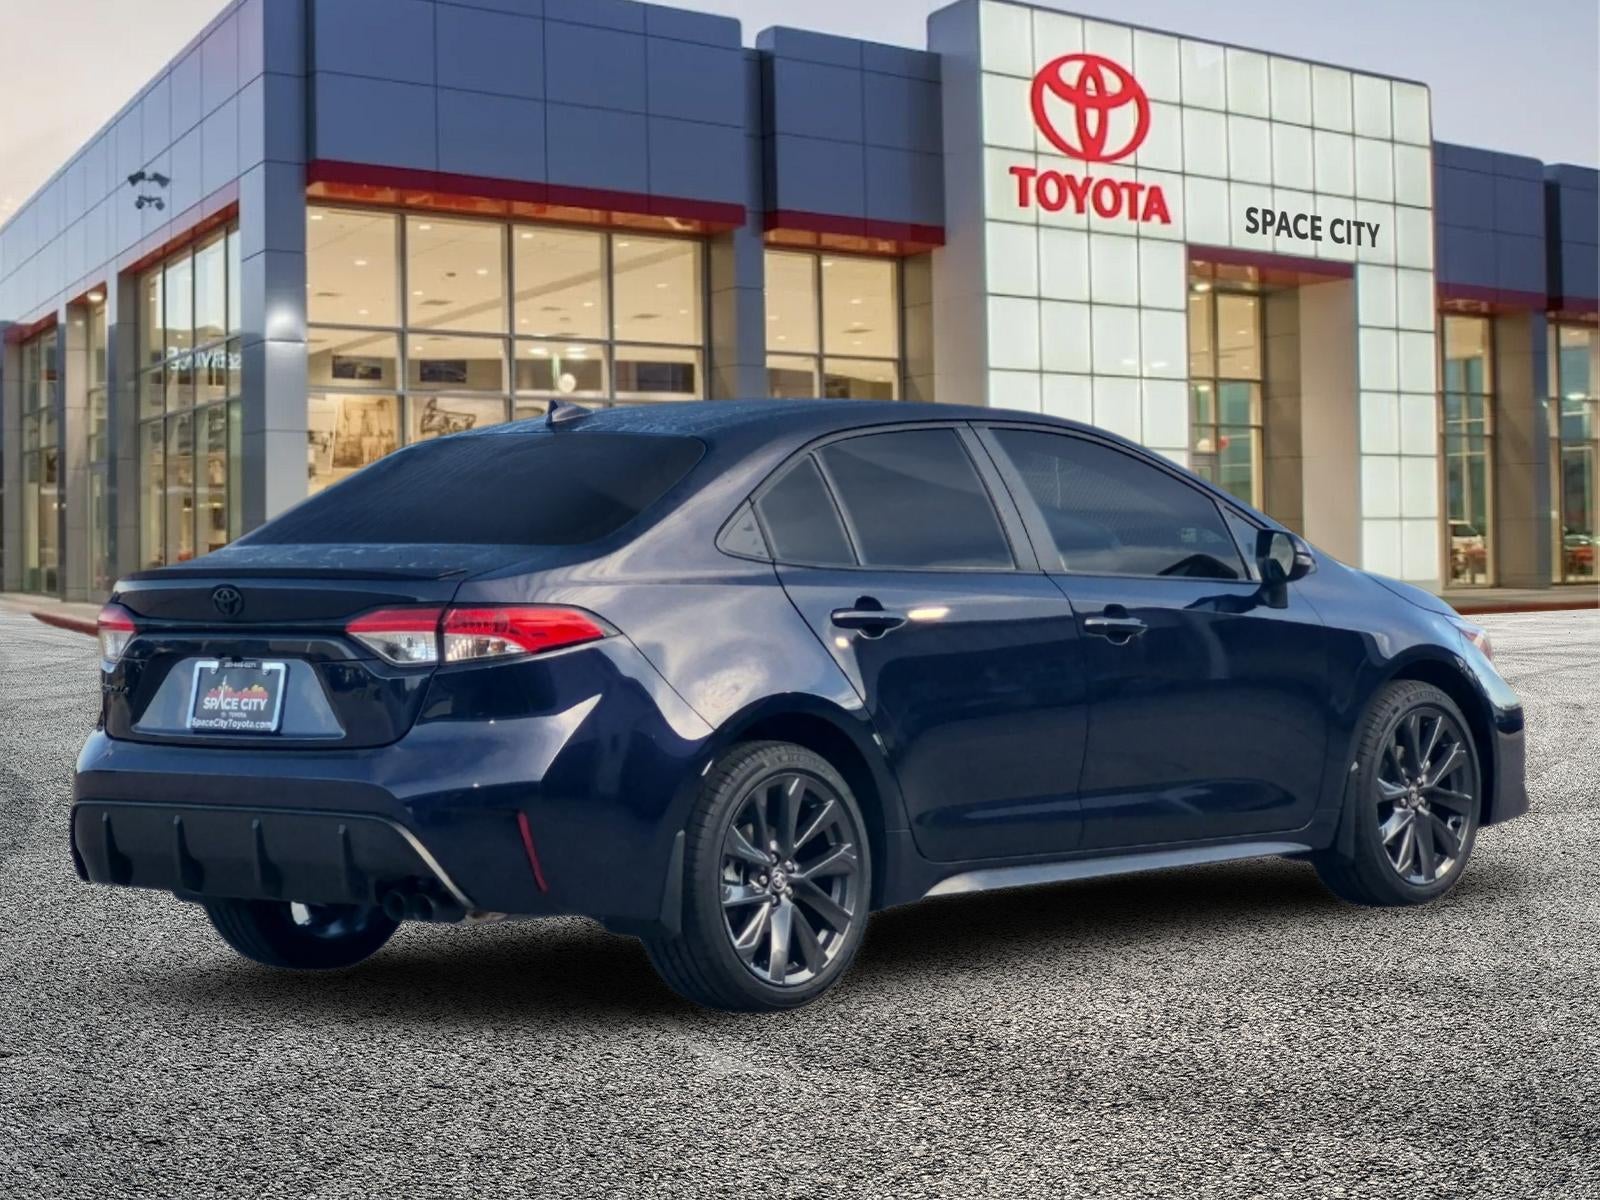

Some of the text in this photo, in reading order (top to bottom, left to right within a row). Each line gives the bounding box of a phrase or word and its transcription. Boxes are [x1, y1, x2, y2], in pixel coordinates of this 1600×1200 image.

[1009, 166, 1171, 224] TOYOTA
[1245, 206, 1381, 248] SPACE CITY
[203, 697, 268, 710] SPACE CITY
[192, 718, 273, 729] SpaceCityToyota.com
